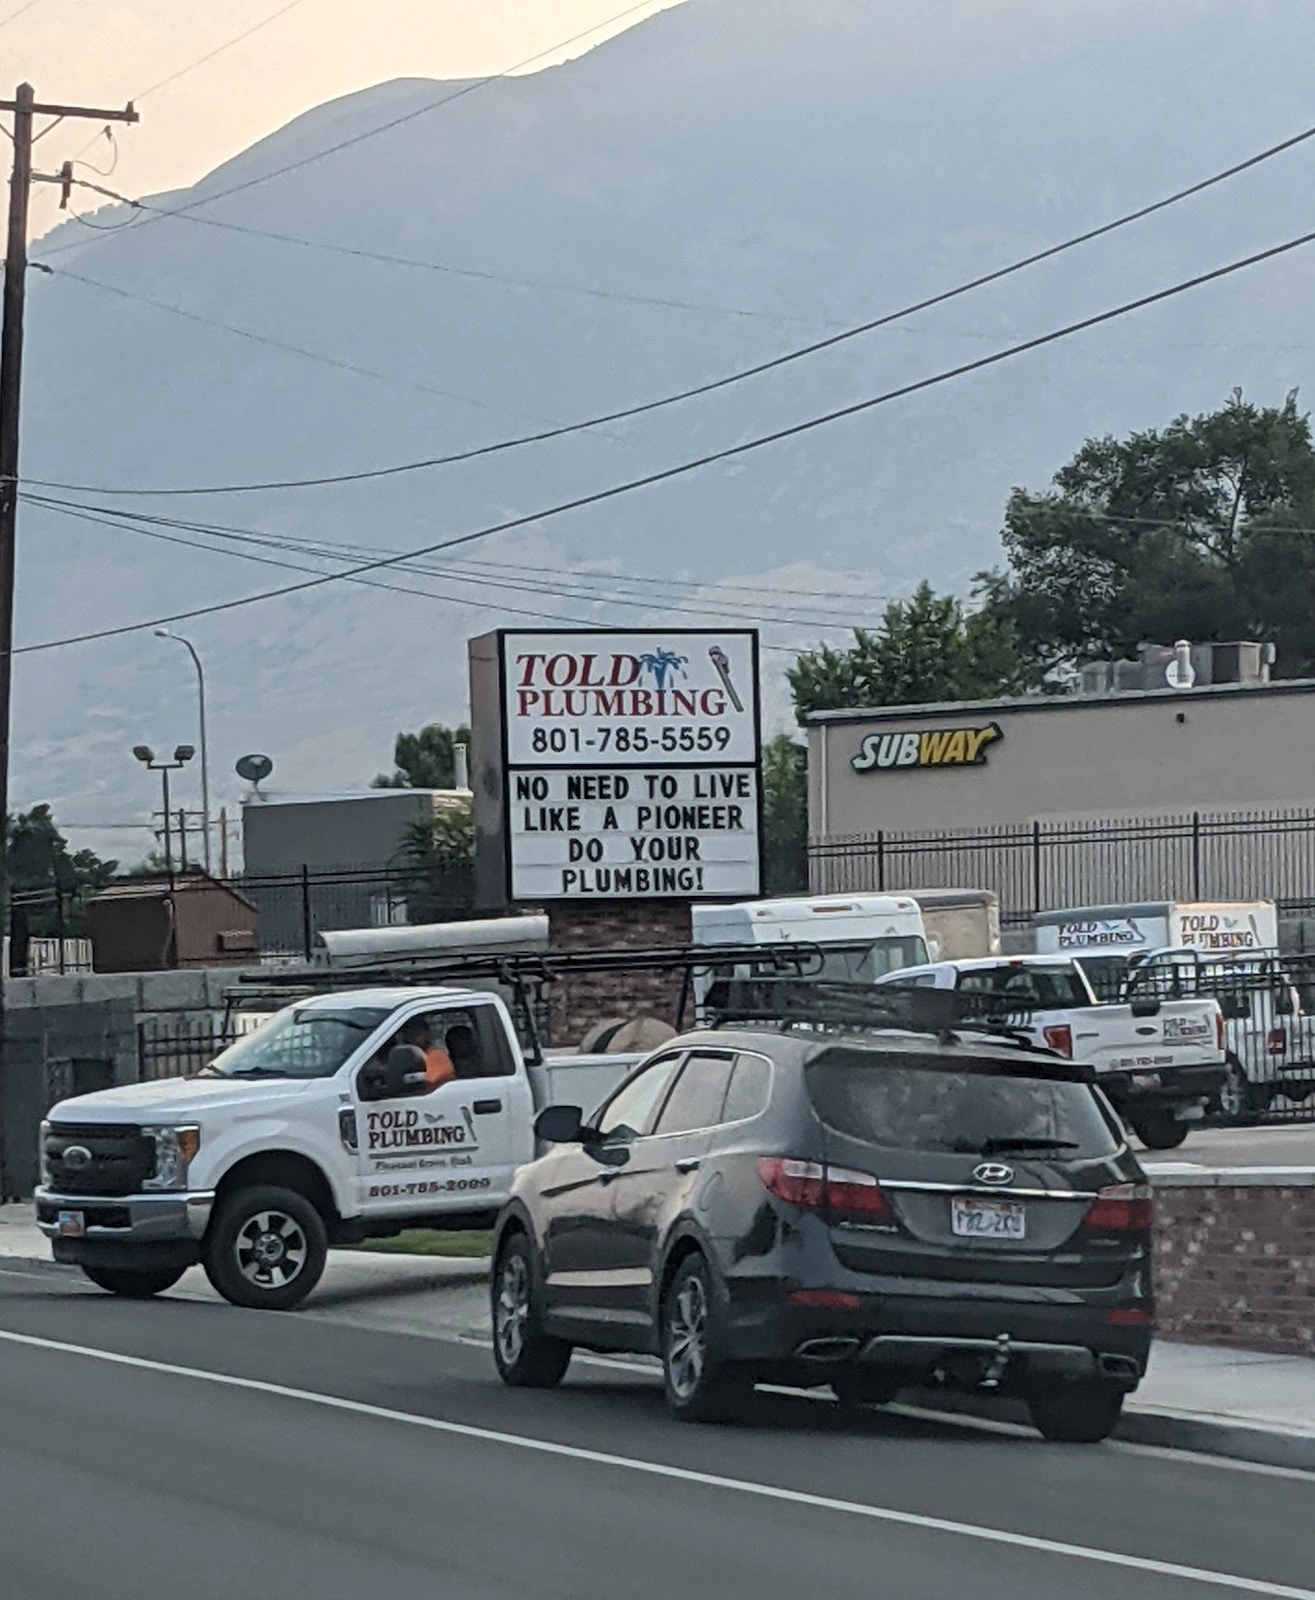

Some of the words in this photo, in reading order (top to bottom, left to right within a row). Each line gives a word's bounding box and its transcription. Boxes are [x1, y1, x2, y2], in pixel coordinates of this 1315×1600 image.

[516, 653, 641, 687] TOLD
[515, 688, 728, 717] PLUMBING
[532, 726, 731, 753] 801-785-5559
[852, 723, 1000, 771] SUBWAY
[516, 776, 549, 800] NO
[567, 775, 630, 800] NEED
[644, 775, 678, 799] TO
[694, 773, 751, 798] LIVE
[524, 807, 581, 832] LIKE
[603, 806, 619, 830] A
[637, 805, 744, 830] PIONEER
[568, 838, 604, 862] DO
[630, 836, 700, 861] YOUR
[562, 867, 704, 893] PLUMBING!
[1181, 915, 1220, 932] TOLD
[367, 1110, 419, 1130] TOLD
[368, 1126, 466, 1150] PLUMBING
